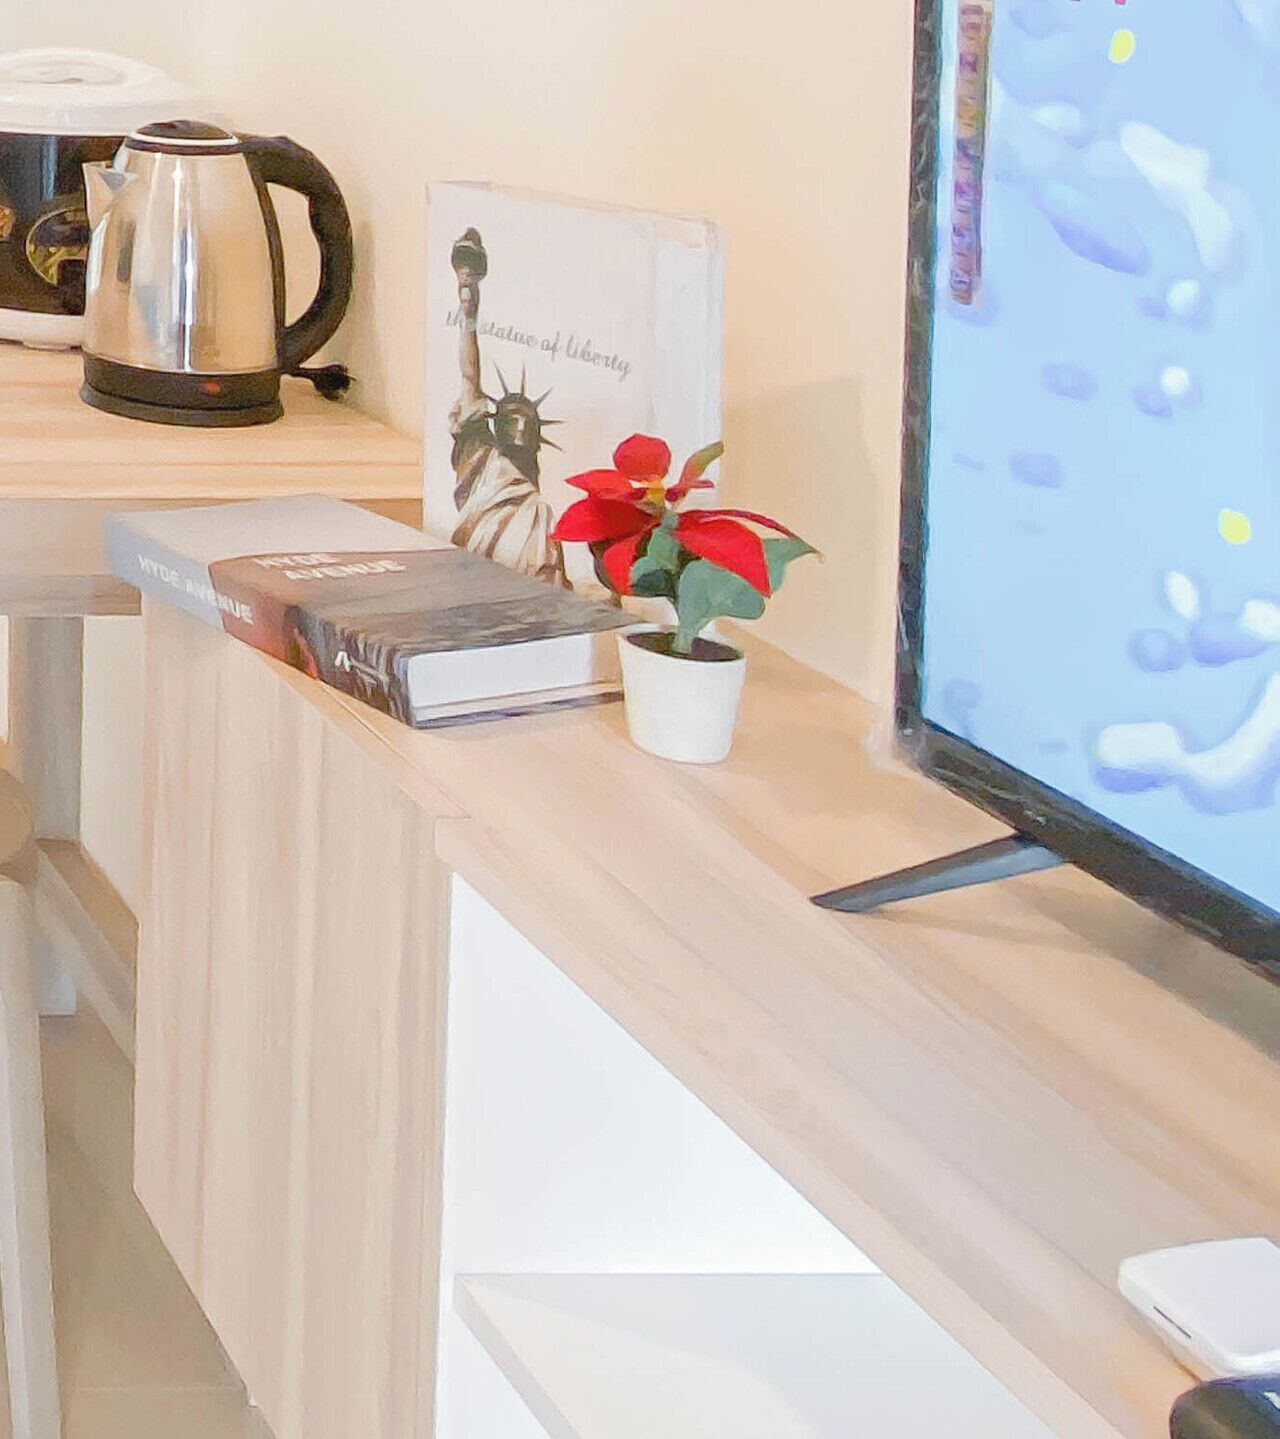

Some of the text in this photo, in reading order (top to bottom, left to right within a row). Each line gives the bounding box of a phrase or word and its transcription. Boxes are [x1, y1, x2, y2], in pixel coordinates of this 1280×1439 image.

[540, 331, 560, 360] of
[566, 334, 630, 382] liberty
[138, 552, 182, 590] HYDE
